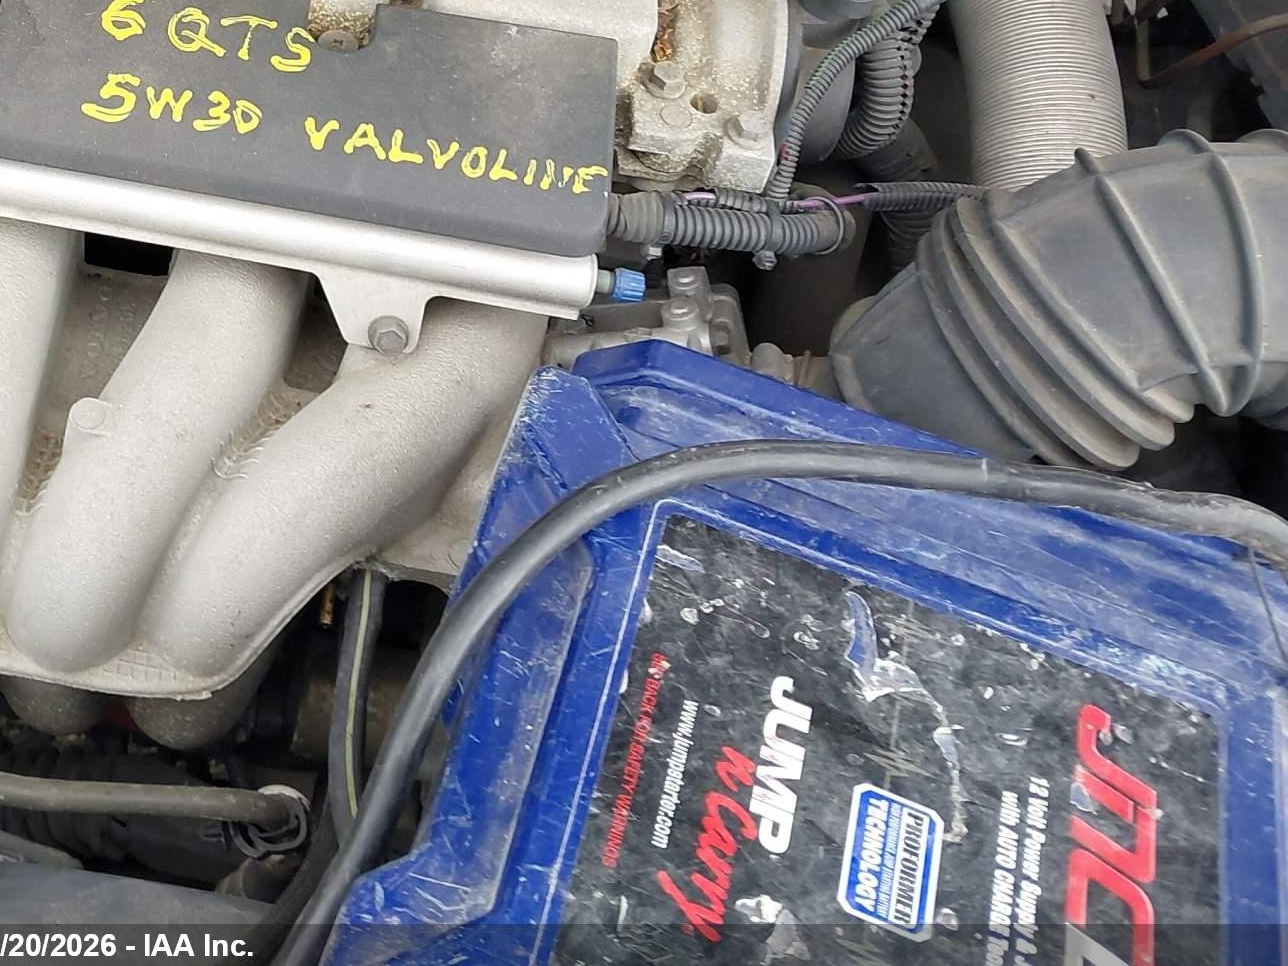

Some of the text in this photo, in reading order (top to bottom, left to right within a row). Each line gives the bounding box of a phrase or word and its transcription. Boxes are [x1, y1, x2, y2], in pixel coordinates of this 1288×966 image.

[167, 6, 316, 73] QTS
[80, 73, 609, 194] 5W30 VALVOLINE
[640, 677, 661, 714] BACK
[633, 714, 652, 742] FOR
[620, 742, 645, 794] SAFETY
[650, 699, 699, 849] www.jumpstarter.com
[748, 676, 813, 854] JUMP
[1028, 776, 1050, 798] 12
[601, 793, 633, 868] WARNINGS
[999, 790, 1021, 826] with
[1026, 797, 1049, 829] Volt
[657, 792, 758, 942] Carry
[854, 798, 889, 912] TECHNOLOGY
[894, 811, 924, 924] PROFORMER
[995, 825, 1019, 869] AUTO
[1022, 827, 1046, 881] Power
[989, 869, 1016, 937] CHARGE
[1013, 880, 1042, 939] Supply
